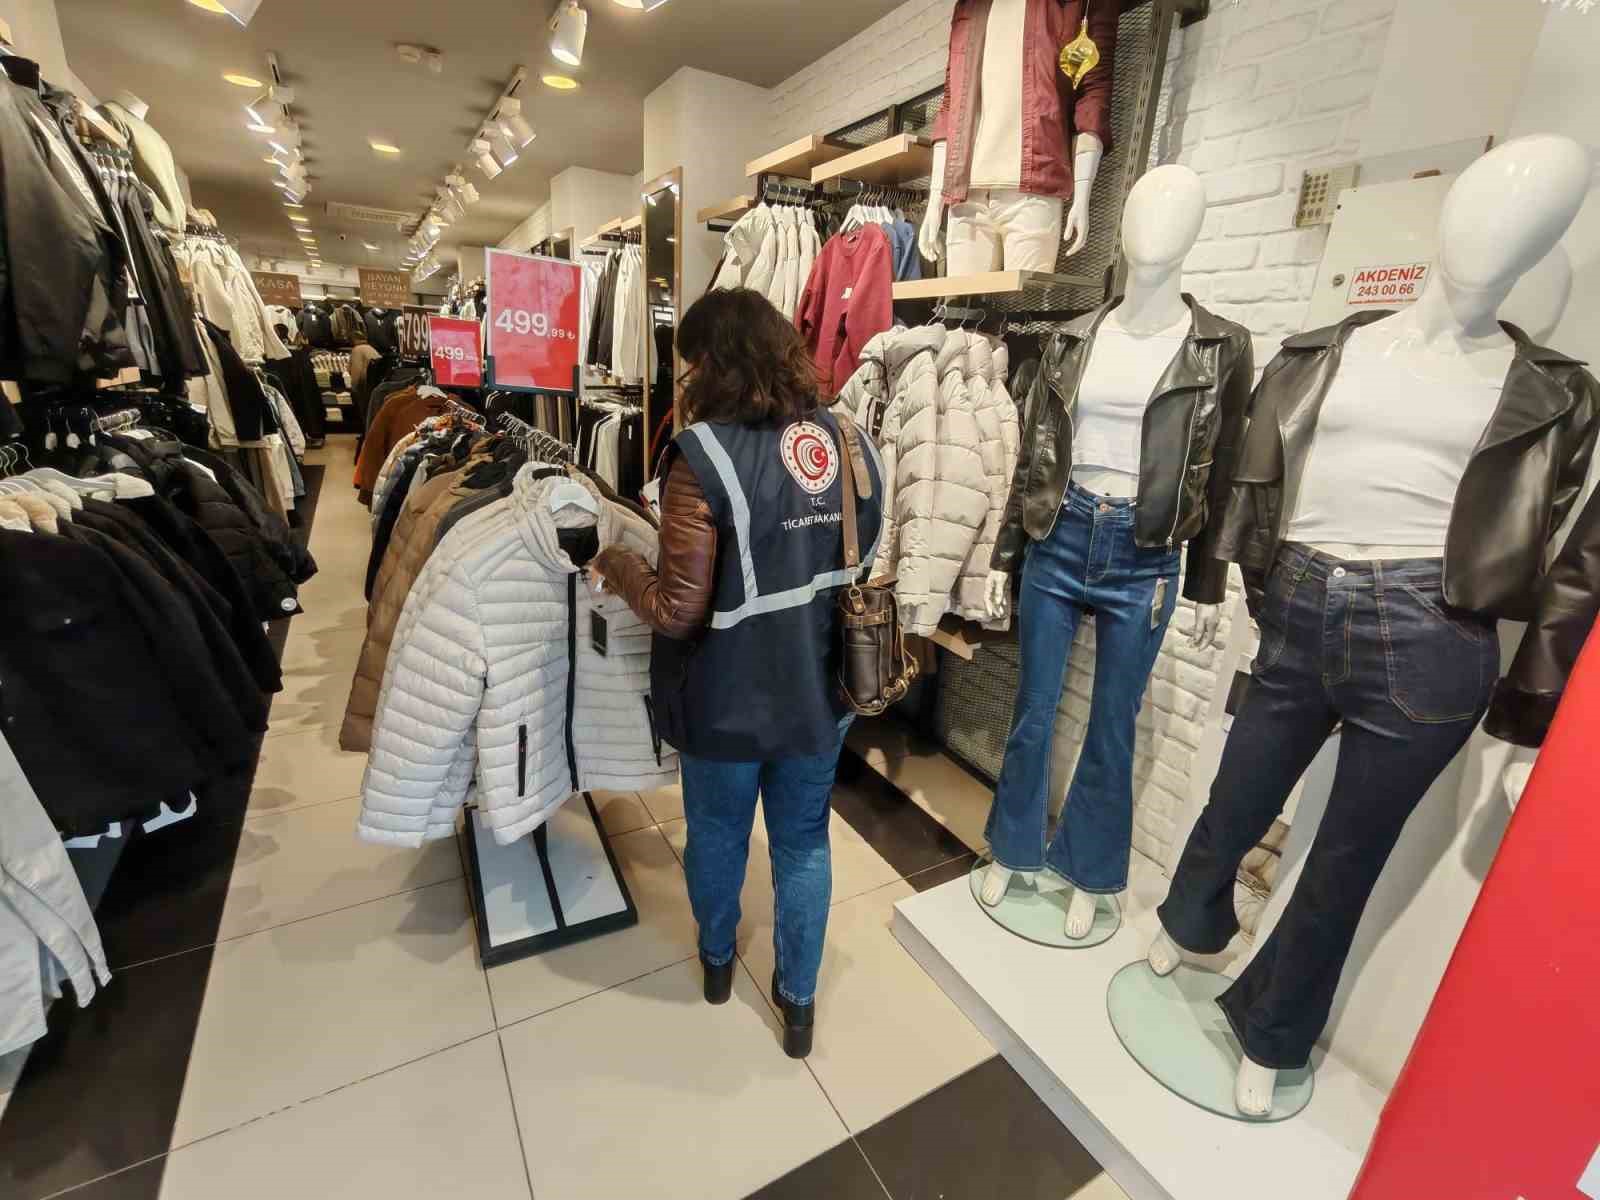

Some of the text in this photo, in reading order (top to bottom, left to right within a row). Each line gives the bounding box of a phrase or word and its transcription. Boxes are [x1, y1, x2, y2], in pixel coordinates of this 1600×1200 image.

[1355, 264, 1426, 283] AKDENİZ
[1358, 283, 1414, 297] 243 00 66
